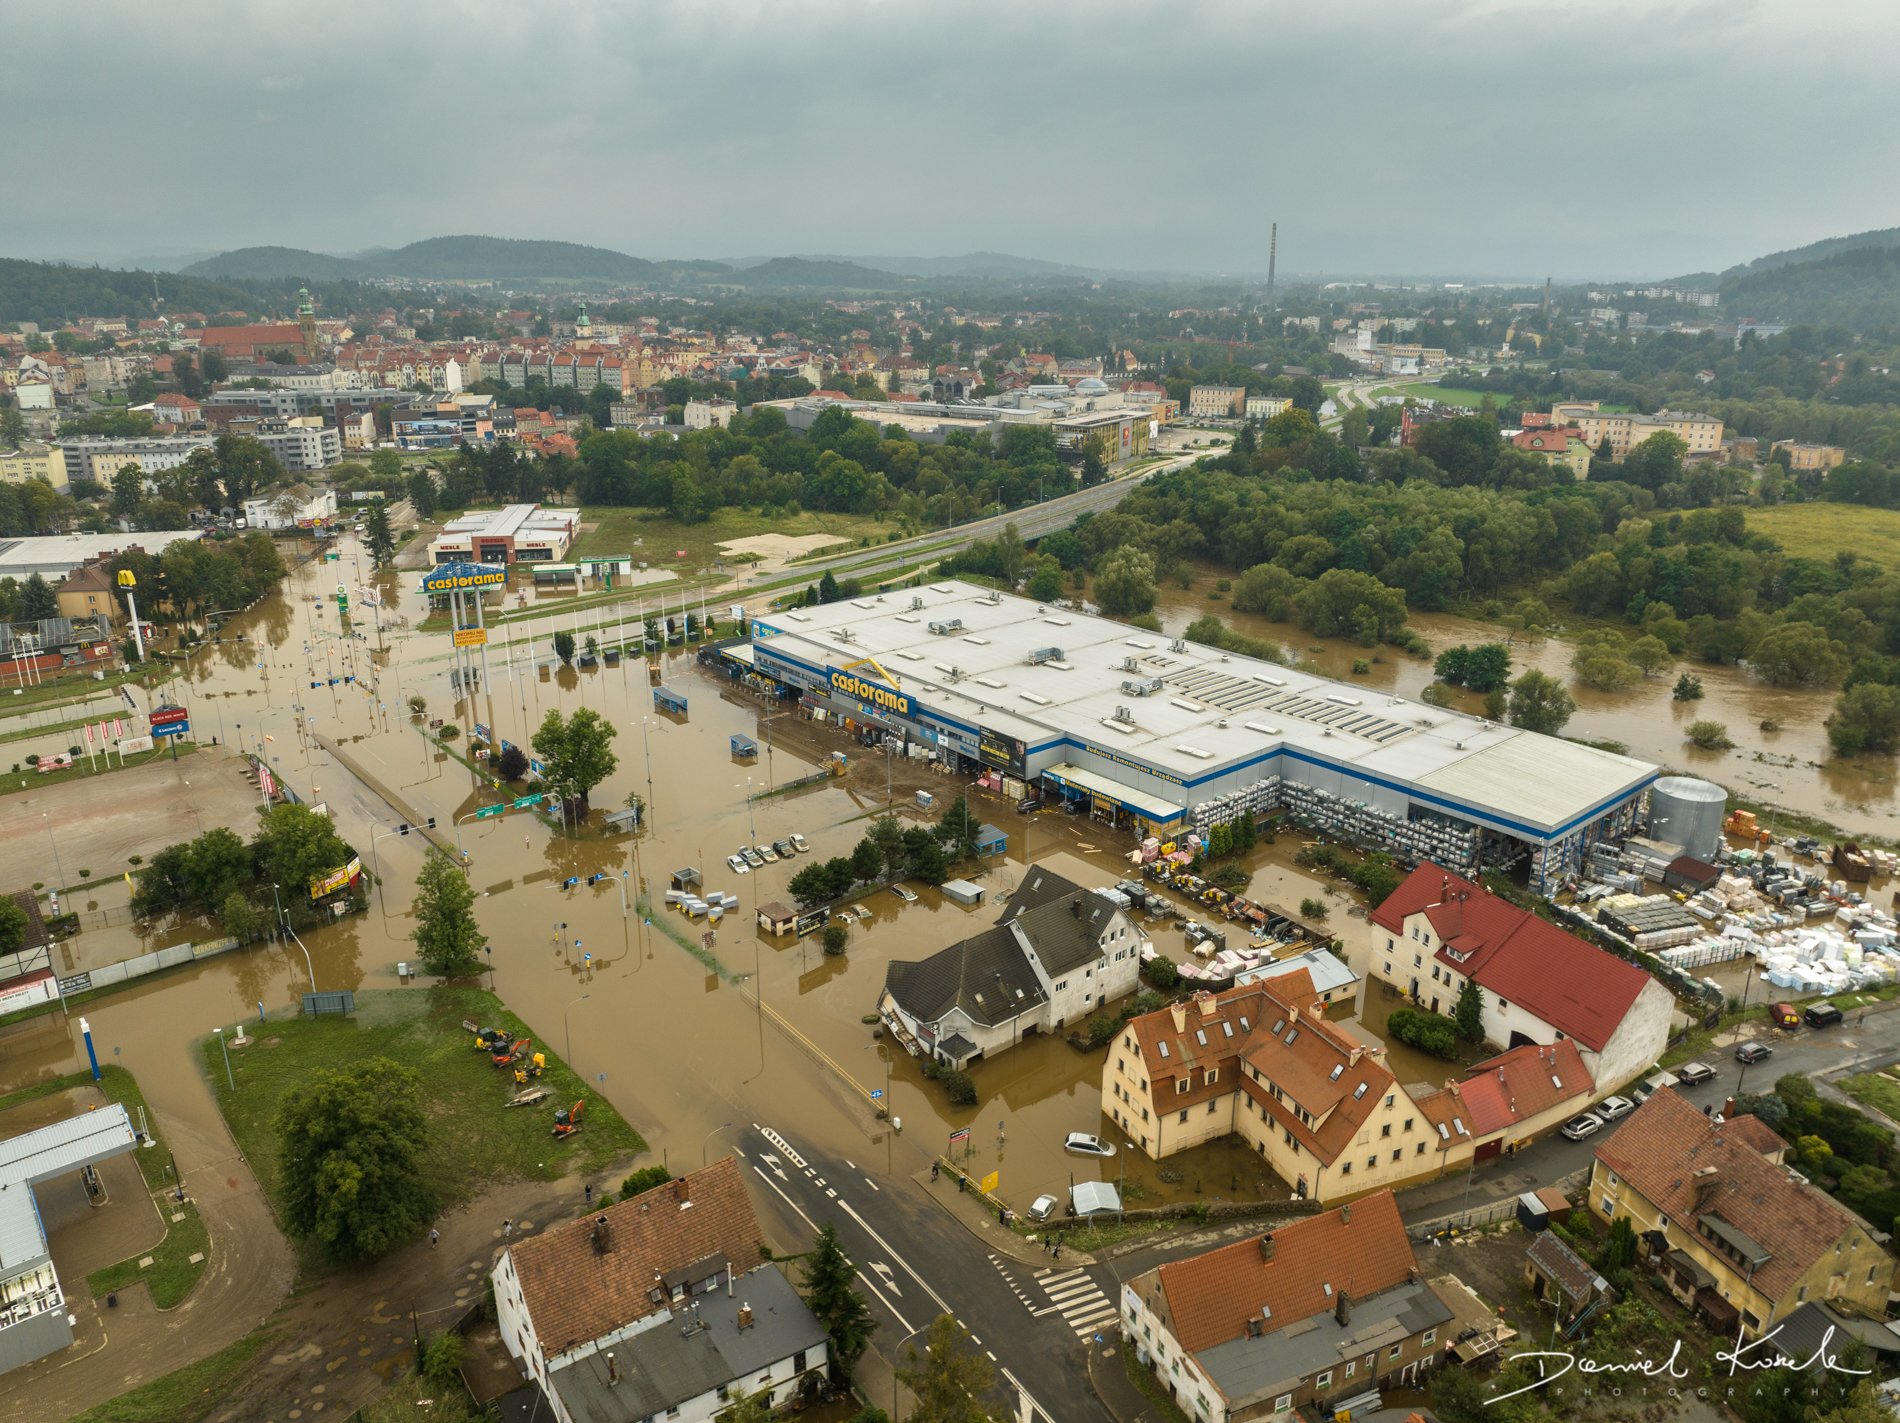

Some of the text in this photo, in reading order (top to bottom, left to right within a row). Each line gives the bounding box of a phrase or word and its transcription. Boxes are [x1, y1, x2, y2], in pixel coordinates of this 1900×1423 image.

[427, 572, 505, 591] castorama
[831, 672, 908, 714] castorama
[1085, 744, 1111, 760] Budujesz
[1112, 755, 1150, 774] Remontujesz
